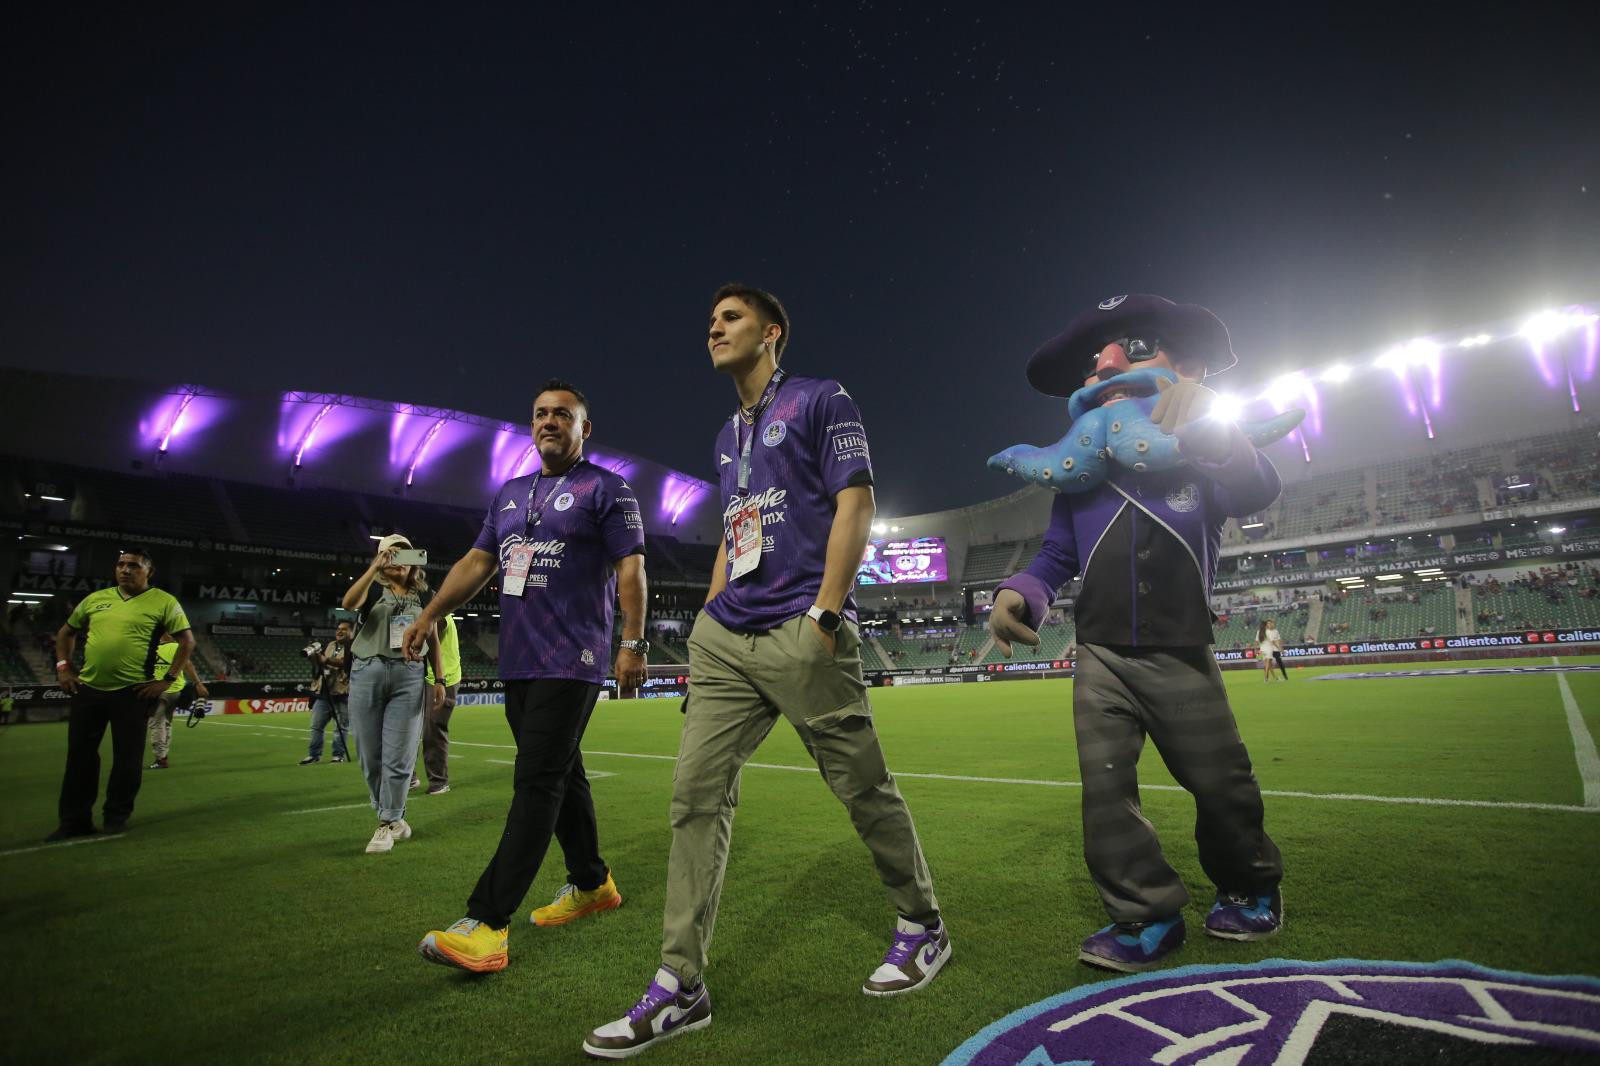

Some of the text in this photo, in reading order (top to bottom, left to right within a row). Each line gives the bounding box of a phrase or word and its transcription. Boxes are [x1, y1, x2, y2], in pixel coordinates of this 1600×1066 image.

[837, 436, 867, 450] Hilto
[838, 453, 852, 461] FOR
[1504, 475, 1520, 484] 12
[65, 527, 120, 540] ENCANTO
[121, 533, 194, 548] DESARROLLOS
[229, 544, 274, 555] ENCANTO
[275, 549, 337, 561] DESARROLLOS
[883, 548, 943, 556] BIENVENIDOS
[502, 558, 561, 569] cae.mx
[1379, 558, 1439, 571] MAZATLAN
[1314, 566, 1370, 578] MAZATLAN
[527, 574, 548, 583] PRESS
[1253, 574, 1304, 585] MAZATLAN
[199, 584, 309, 604] MAZATLAN
[651, 609, 695, 619] MAZATL
[1446, 634, 1523, 648] caliente.mx
[1558, 630, 1600, 642] calien
[1281, 646, 1325, 657] ente.mx
[1350, 641, 1417, 653] caliente.mx
[1004, 662, 1051, 671] caliente.mx
[903, 676, 944, 685] caliente.mx
[264, 700, 310, 713] Soria
